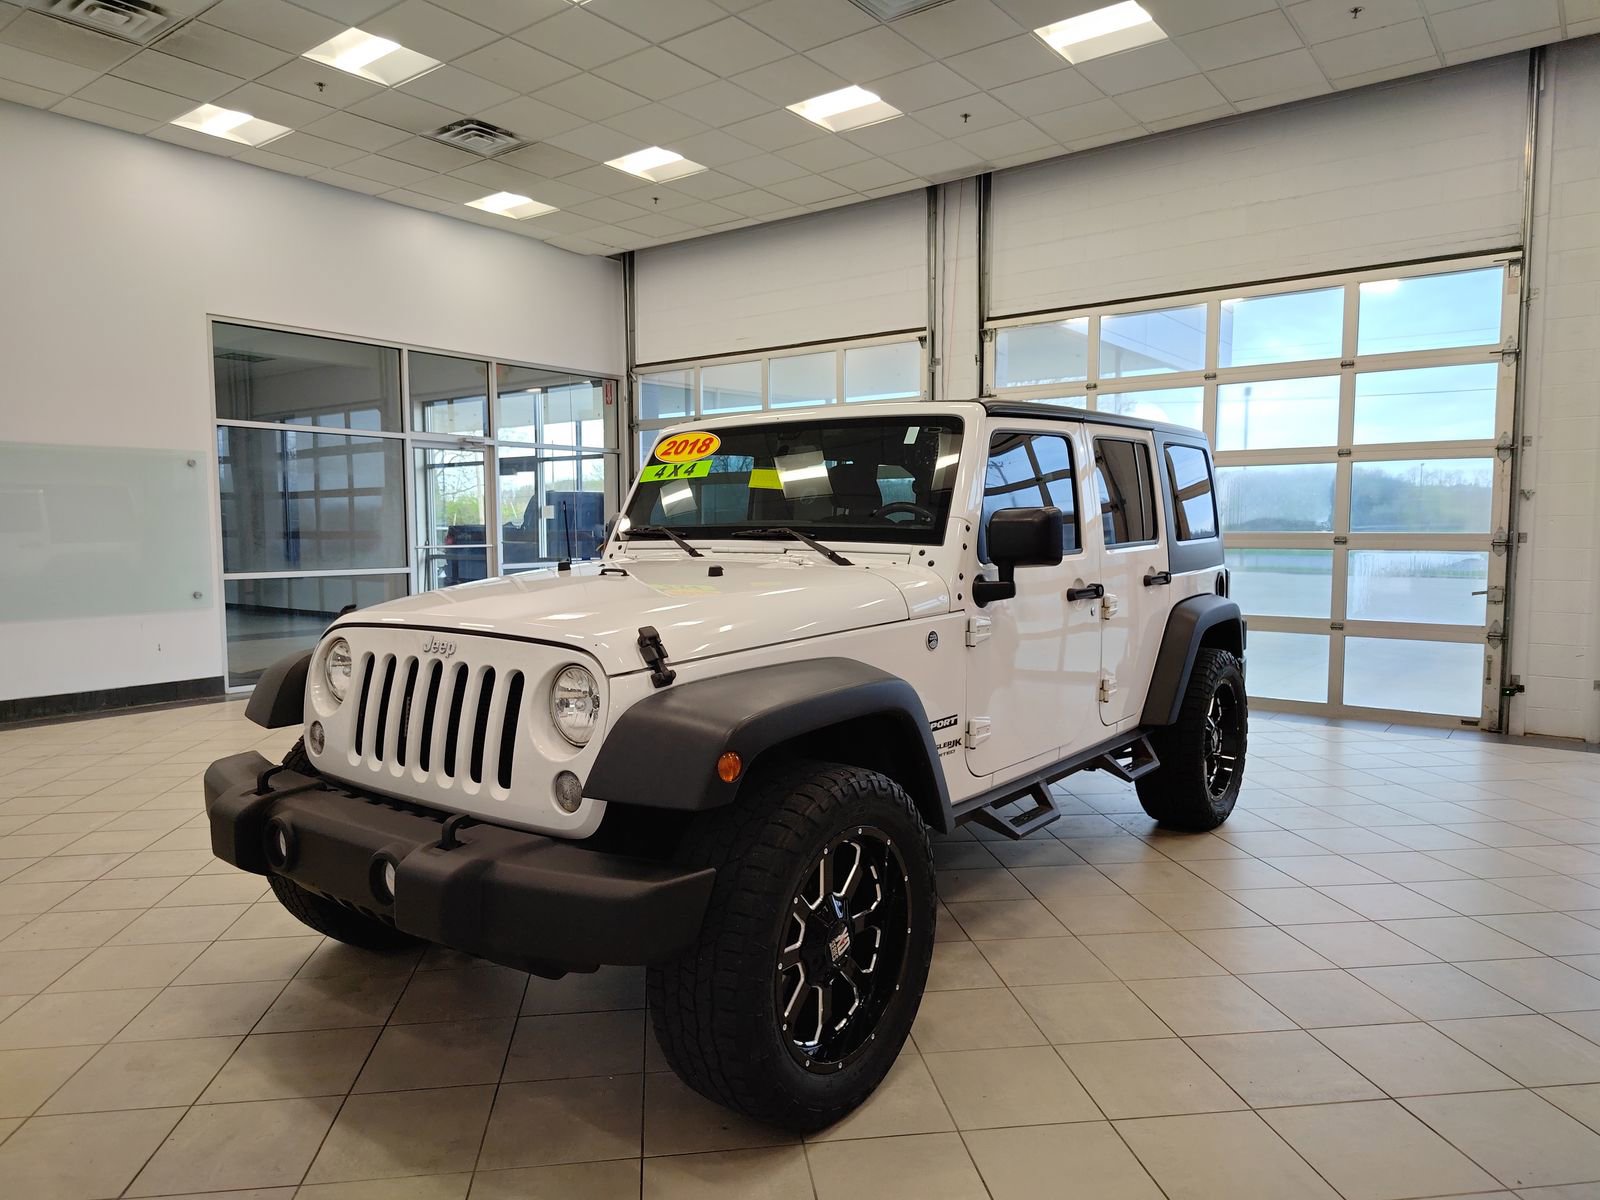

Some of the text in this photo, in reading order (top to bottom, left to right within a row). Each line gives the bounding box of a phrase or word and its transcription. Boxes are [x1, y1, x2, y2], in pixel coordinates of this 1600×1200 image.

[660, 437, 714, 456] 2018
[654, 463, 697, 478] 4X4
[423, 636, 456, 658] Jeep
[930, 716, 958, 730] PORT
